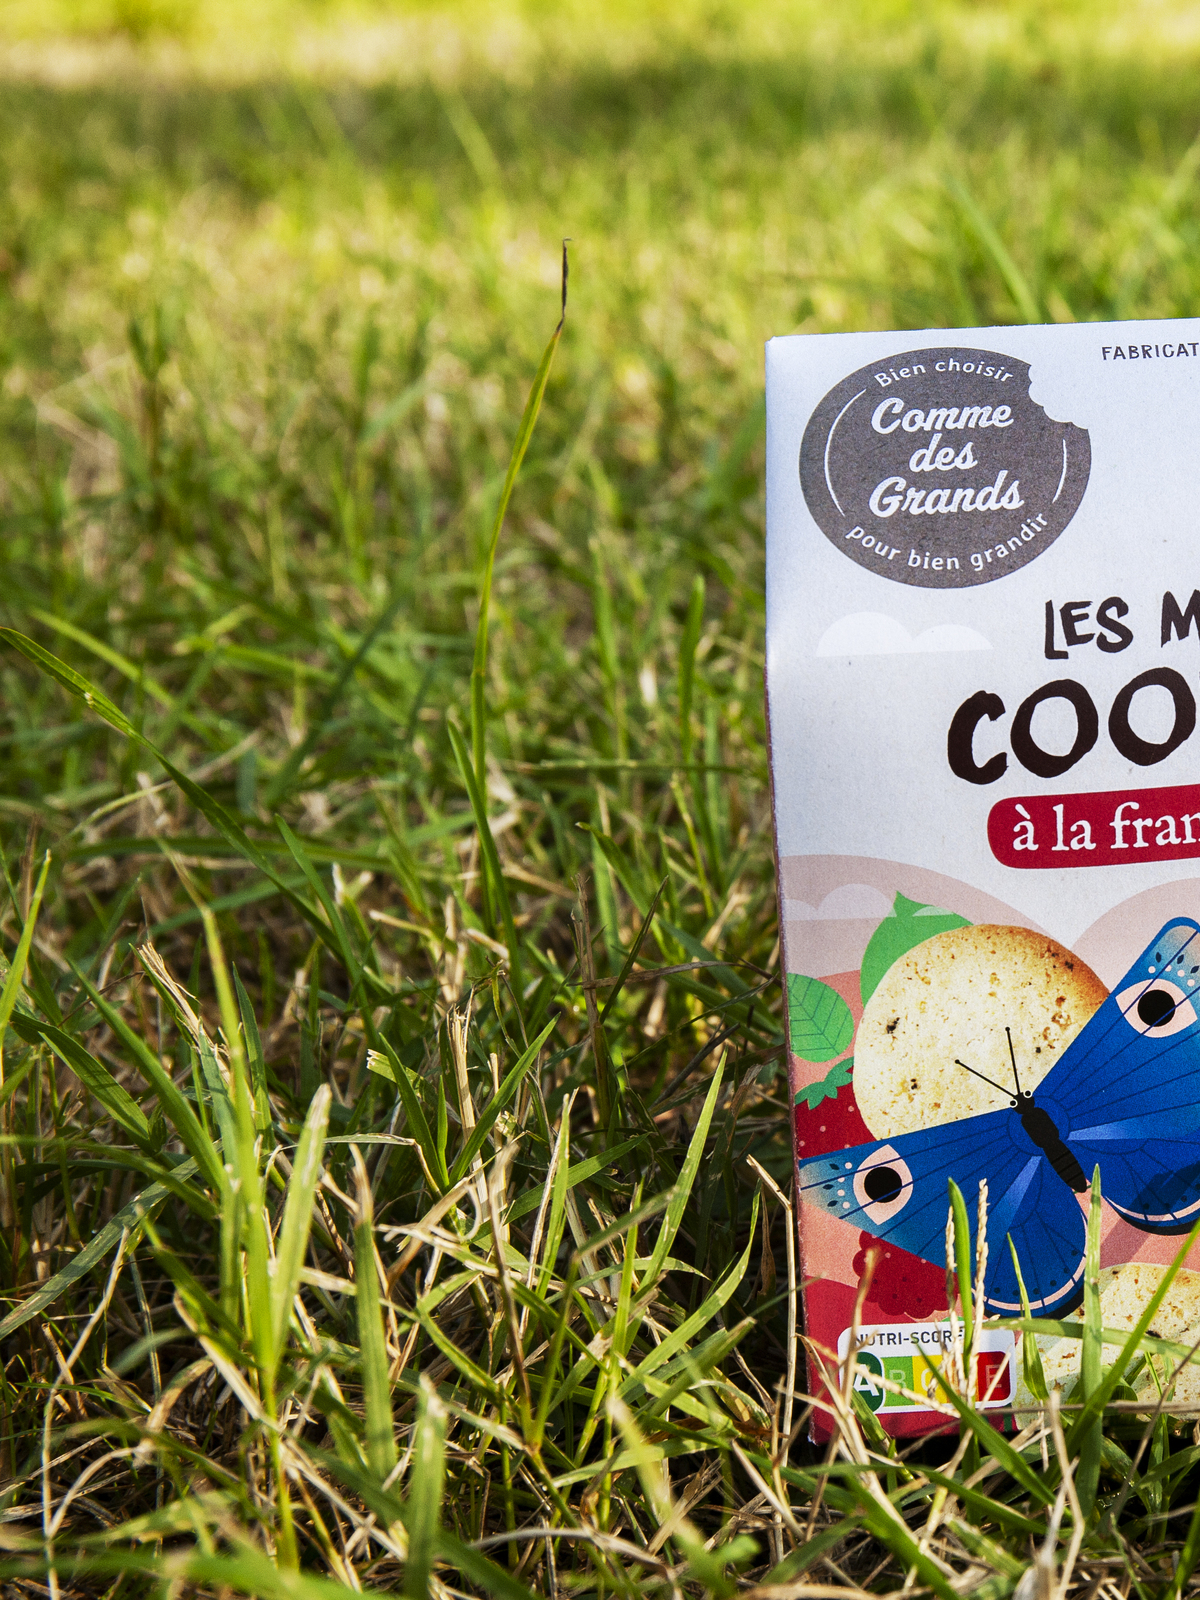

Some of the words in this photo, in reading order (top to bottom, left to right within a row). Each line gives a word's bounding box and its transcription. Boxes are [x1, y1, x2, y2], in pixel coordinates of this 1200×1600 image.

[874, 361, 926, 388] Bien
[934, 358, 1013, 383] choisir
[871, 397, 1014, 434] Comme
[909, 433, 978, 472] des
[869, 470, 1025, 518] Grands
[846, 525, 901, 561] pour
[908, 550, 959, 570] bien
[970, 513, 1048, 571] grandir
[1044, 597, 1134, 660] LES
[1012, 804, 1039, 852] à
[1052, 803, 1097, 852] la
